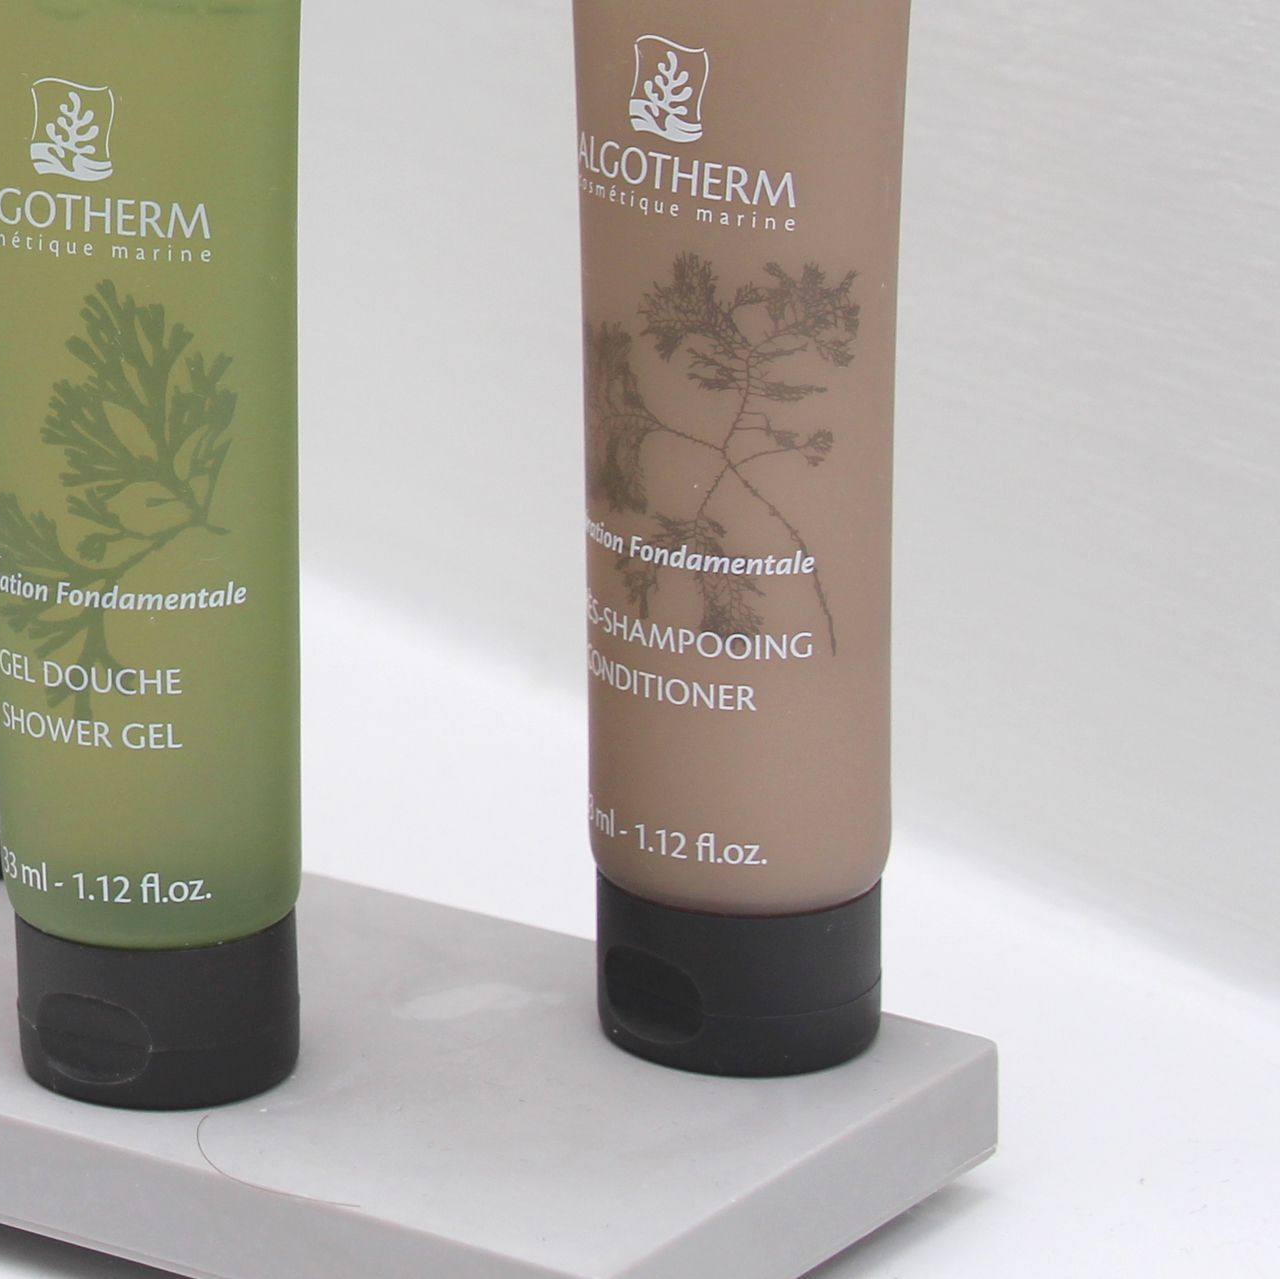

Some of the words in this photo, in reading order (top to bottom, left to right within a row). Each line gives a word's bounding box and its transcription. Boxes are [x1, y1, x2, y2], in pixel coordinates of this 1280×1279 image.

[578, 131, 797, 209] ALGOTHERM
[696, 207, 797, 232] marine
[111, 244, 212, 263] marine
[586, 518, 624, 554] ation
[630, 535, 815, 577] Fondamentale
[56, 581, 247, 611] Fondamentale
[0, 649, 36, 683] GEL
[43, 660, 183, 695] DOUCHE
[2, 702, 112, 748] SHOWER
[122, 723, 183, 749] GEL
[595, 808, 615, 838] ml
[635, 824, 687, 859] 1.12
[695, 832, 768, 865] fl.oz.
[3, 846, 17, 879] 33
[21, 862, 48, 892] ml
[72, 872, 132, 903] 1.12
[140, 872, 212, 904] fl.oz.
